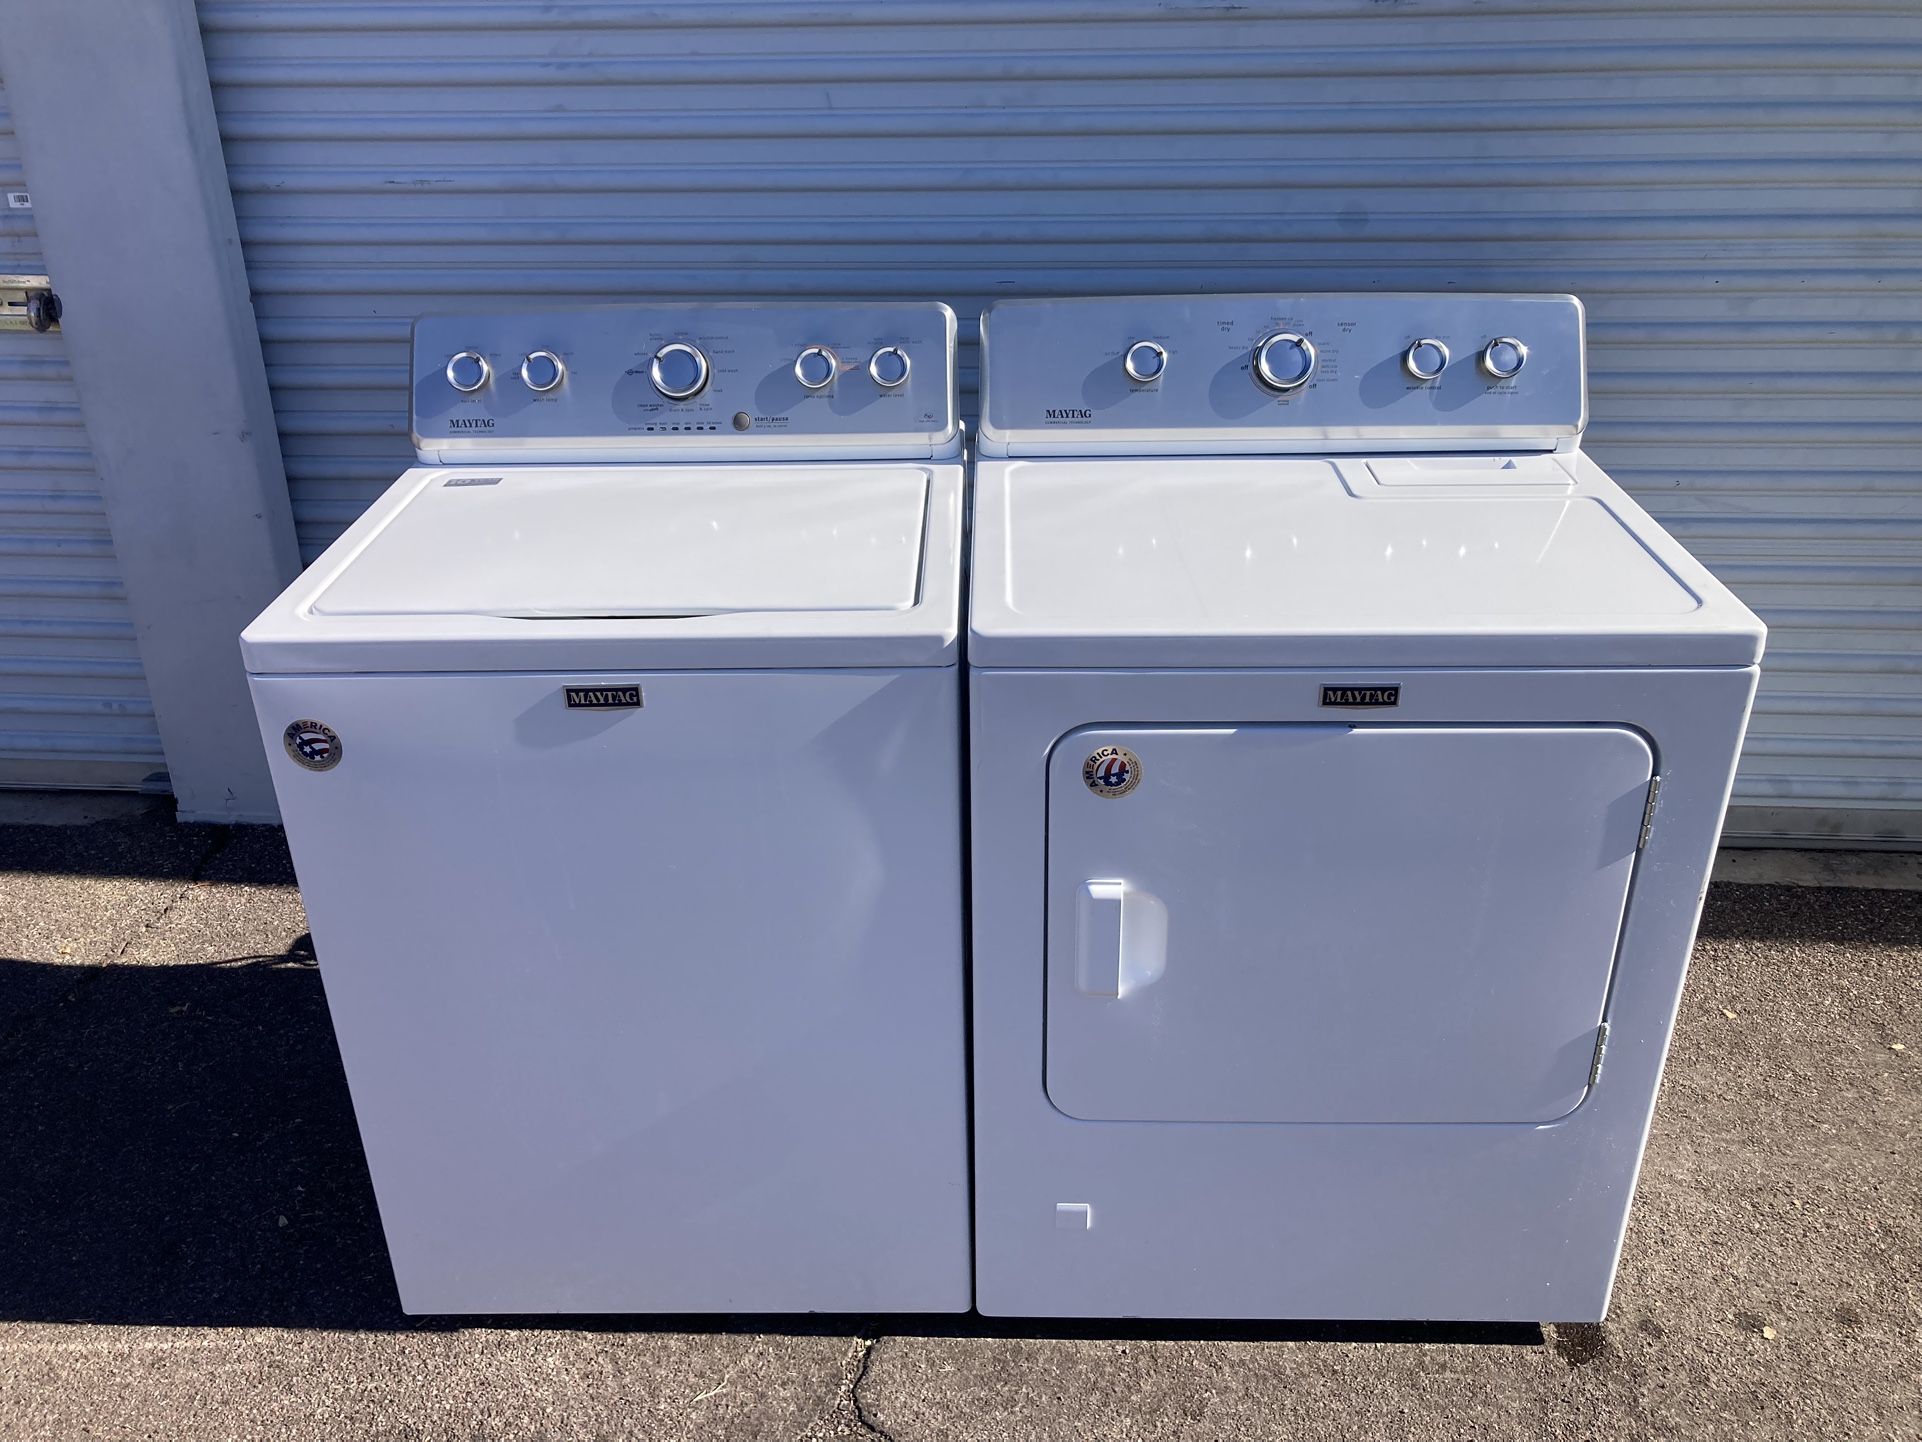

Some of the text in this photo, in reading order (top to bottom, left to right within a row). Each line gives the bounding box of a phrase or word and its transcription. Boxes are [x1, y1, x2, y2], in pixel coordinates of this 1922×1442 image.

[1045, 409, 1092, 419] MAYTAG
[449, 418, 495, 428] MAYTAG
[569, 691, 637, 704] MAYTAG
[1326, 690, 1395, 703] MAYTAG
[287, 720, 337, 743] AMERICA
[1085, 748, 1118, 787] AMERICA
